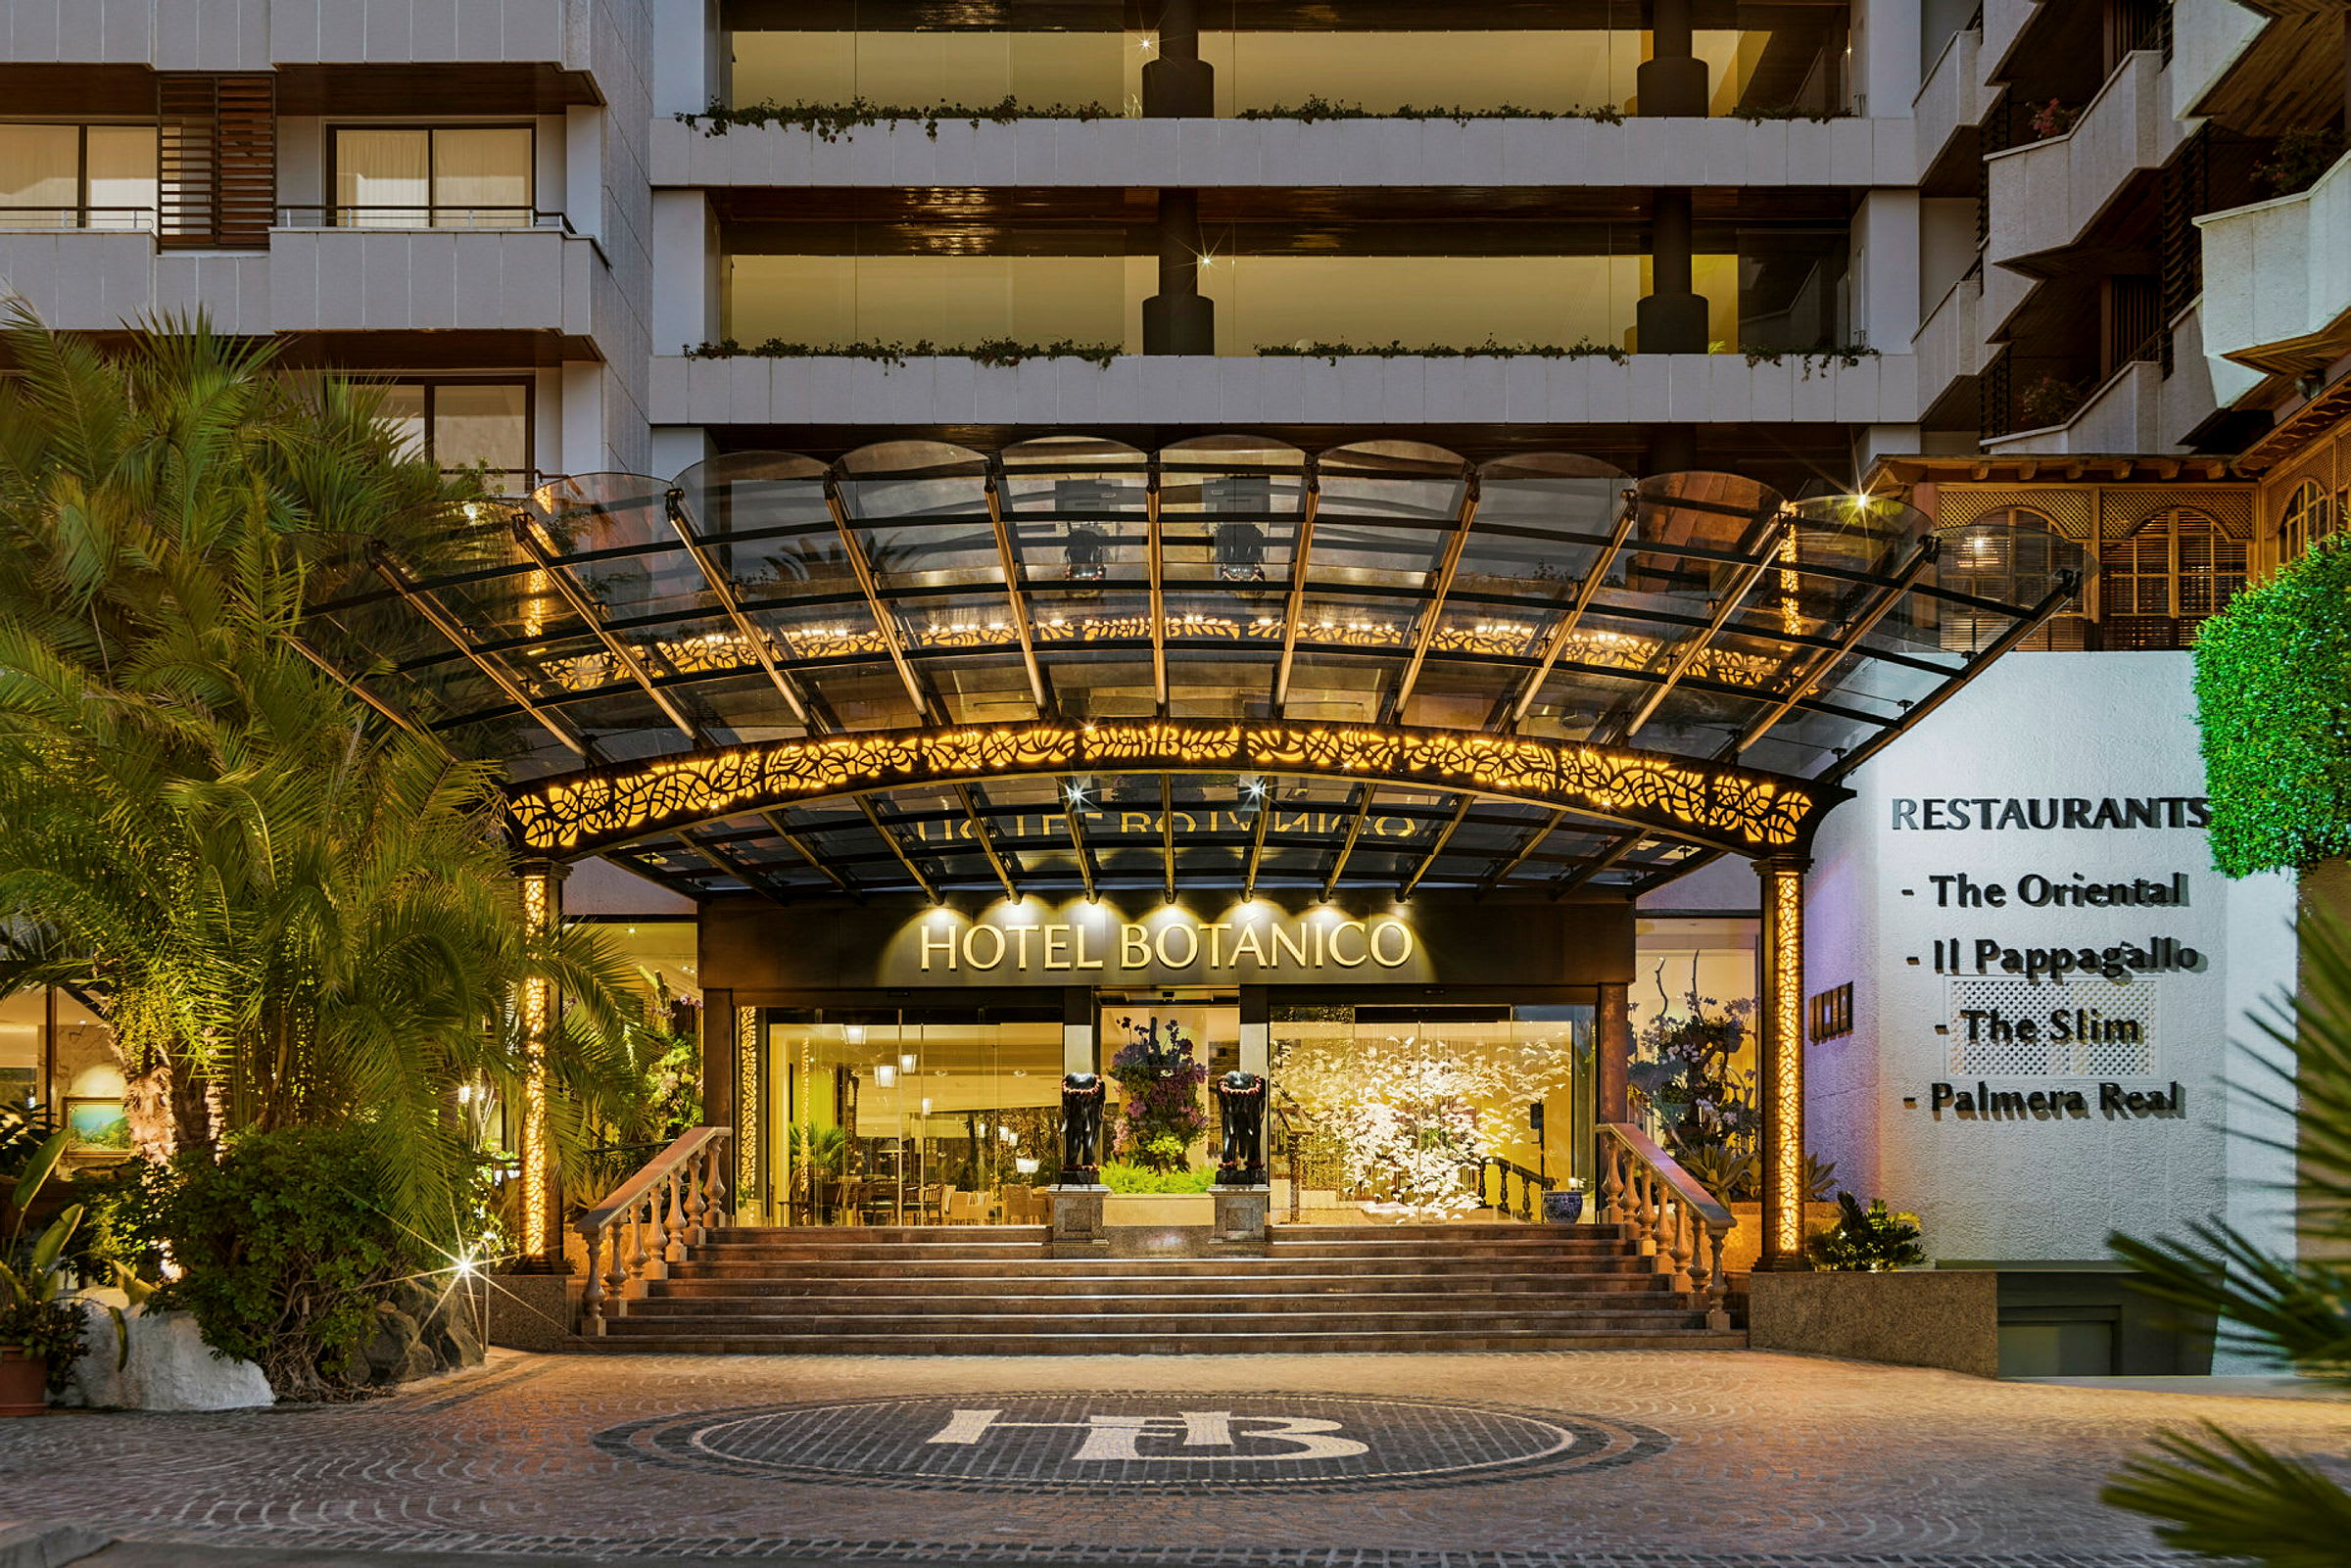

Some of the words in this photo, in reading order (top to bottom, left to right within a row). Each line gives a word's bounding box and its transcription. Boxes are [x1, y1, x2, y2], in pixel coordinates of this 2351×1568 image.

[1892, 797, 2212, 830] RESTAURANTS
[1929, 872, 2006, 907] The
[2018, 872, 2188, 907] Oriental
[920, 923, 1103, 970] HOTEL
[1120, 916, 1414, 969] BOTÁNICO
[1975, 936, 2206, 985] Pappagallo
[1960, 1009, 2039, 1044] The
[2049, 1009, 2142, 1044] Slim
[1932, 1080, 2087, 1118] Palmera
[2099, 1080, 2184, 1118] Real
